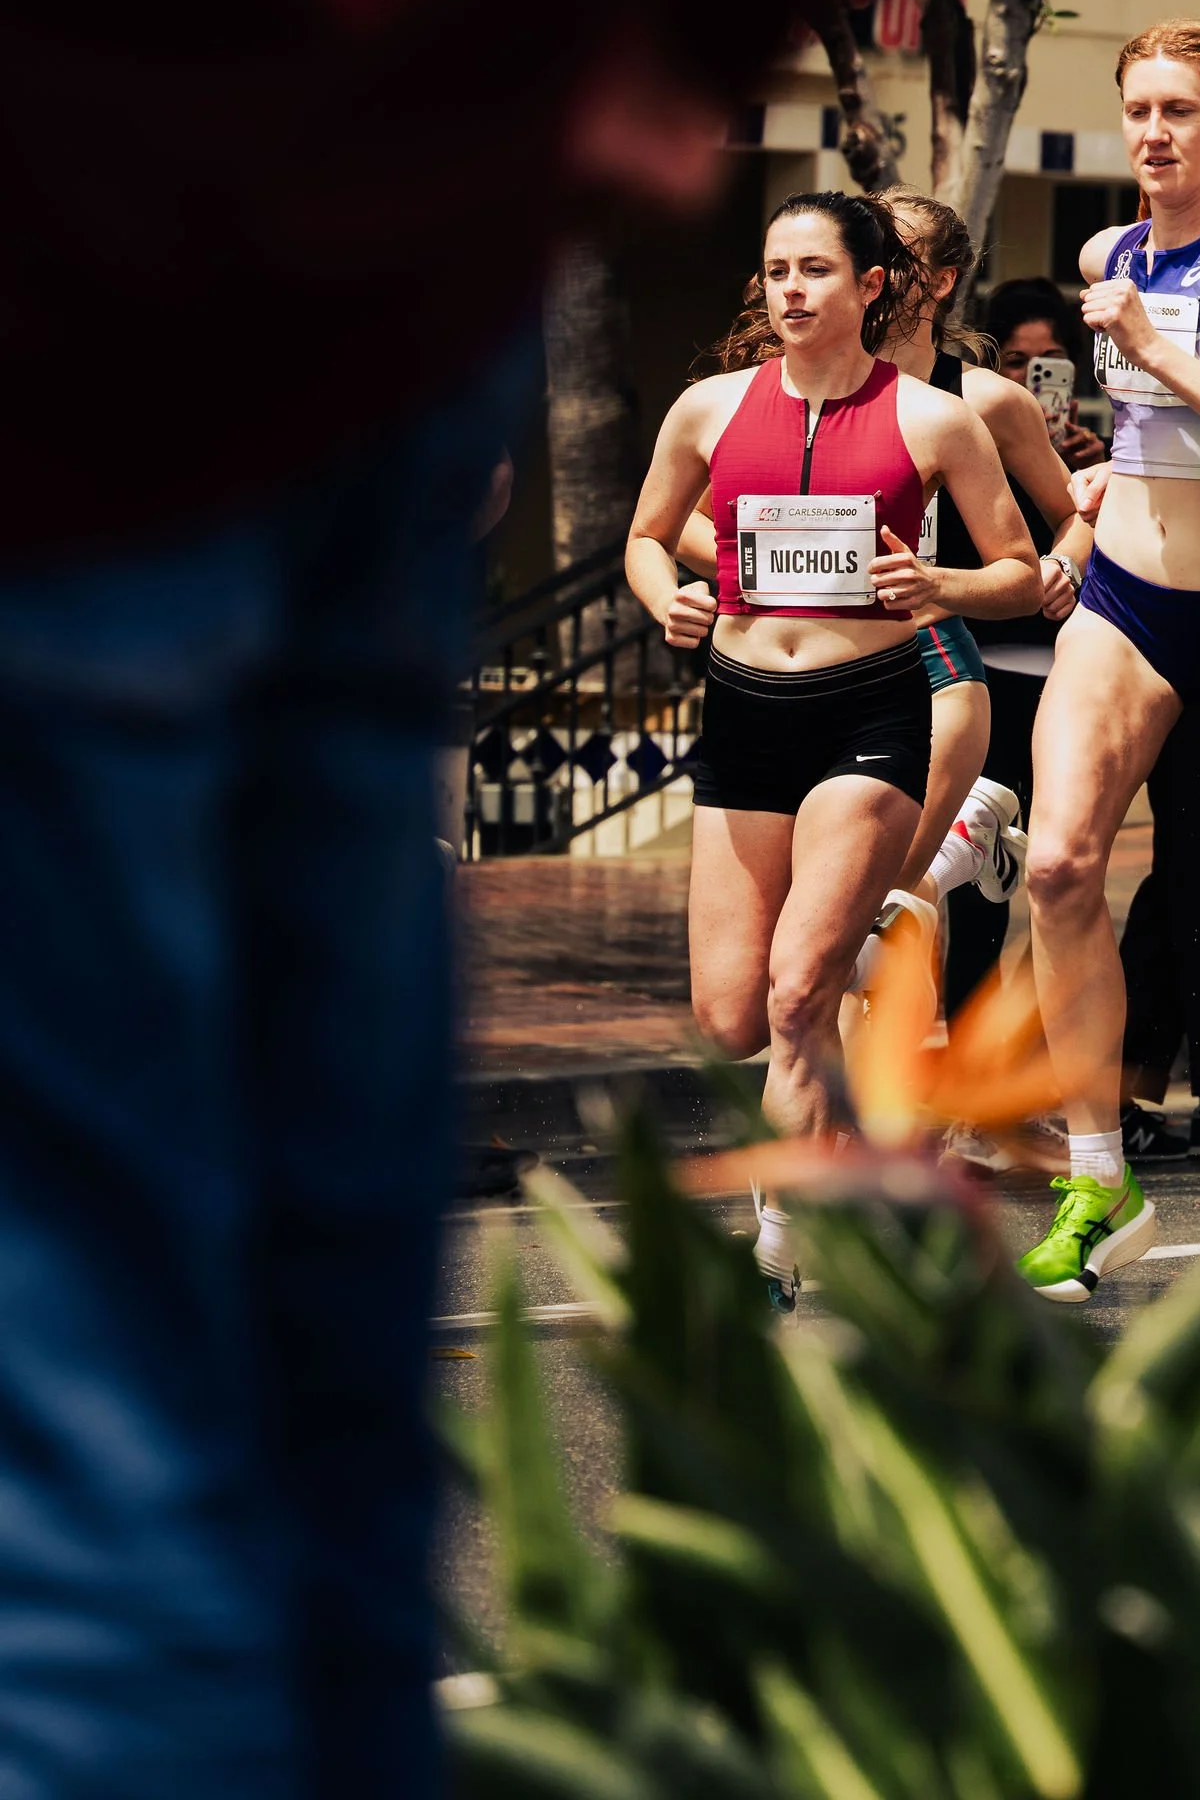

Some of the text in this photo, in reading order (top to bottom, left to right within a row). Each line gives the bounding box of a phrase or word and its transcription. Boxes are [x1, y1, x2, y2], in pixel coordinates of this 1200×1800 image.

[788, 508, 858, 517] CARLSBAD5000
[745, 547, 753, 575] ELITE
[770, 550, 858, 574] NICHOLS
